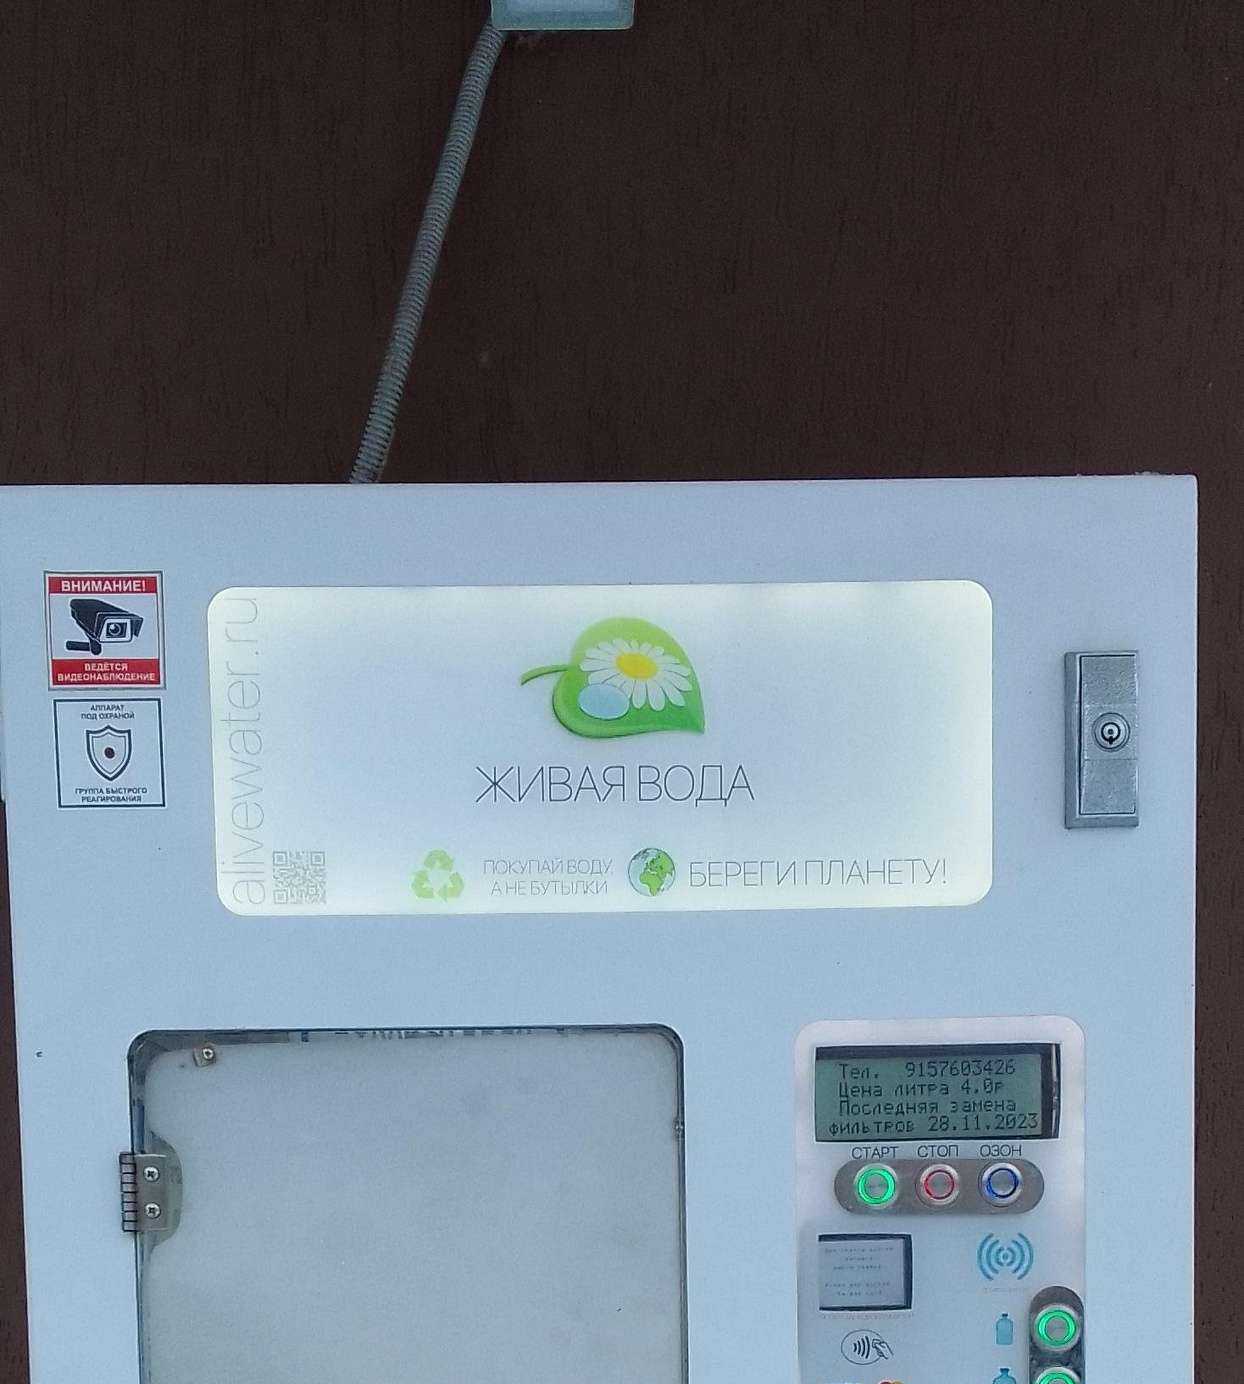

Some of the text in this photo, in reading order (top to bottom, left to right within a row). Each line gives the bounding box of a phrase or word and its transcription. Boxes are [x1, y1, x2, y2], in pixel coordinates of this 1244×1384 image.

[61, 579, 146, 593] ВНИМАНИЕ!
[57, 672, 155, 682] ВИДЕОНАБЛЮДЕНИЕ
[81, 711, 135, 720] ПОД ОХРАНОЙ
[90, 704, 124, 712] АППАРАТ
[220, 597, 266, 906] alivewater.ru
[75, 786, 148, 795] ГРУППА БЫСТРОГО
[475, 764, 755, 807] ЖИВАЯ ВОДА
[81, 794, 142, 803] РЕАГИРОВАНИЯ
[482, 856, 563, 875] ПОКУПАЙ
[689, 857, 948, 888] БЕРЕГИ ПЛАНЕТУ!
[490, 880, 608, 896] А НЕ БУТЫЛКИ
[839, 1063, 880, 1079] Тел.
[839, 1081, 883, 1099] Цена
[894, 1082, 949, 1096] литра
[839, 1100, 1017, 1116] Последняя замена
[829, 1113, 1038, 1136] фильтров 28.11.2023
[851, 1146, 899, 1159] СТАРТ
[917, 1145, 958, 1157] СТОП
[979, 1144, 1022, 1157] ОЗОН
